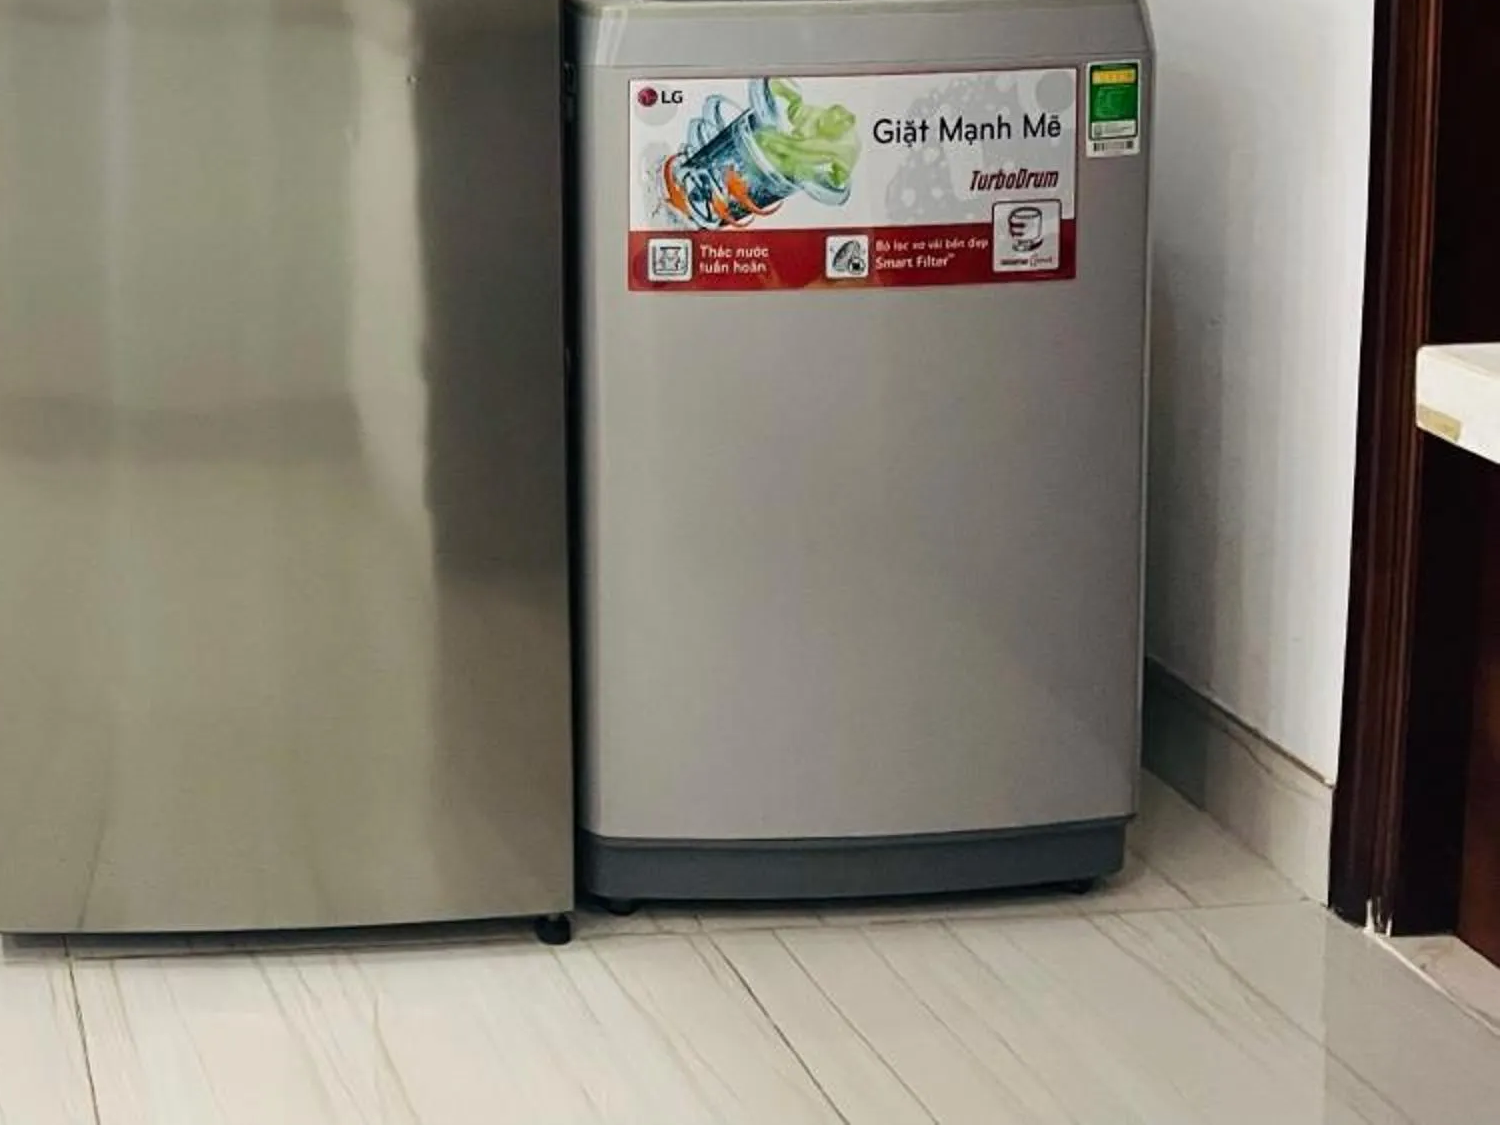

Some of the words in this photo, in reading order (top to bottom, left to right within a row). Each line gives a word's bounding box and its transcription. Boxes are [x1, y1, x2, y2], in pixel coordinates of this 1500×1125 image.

[661, 90, 683, 104] LG
[873, 118, 930, 147] Giặt
[939, 115, 1012, 145] Mạnh
[1023, 112, 1061, 138] Mẽ
[969, 168, 1059, 191] TurboDrum
[875, 256, 913, 270] Smart
